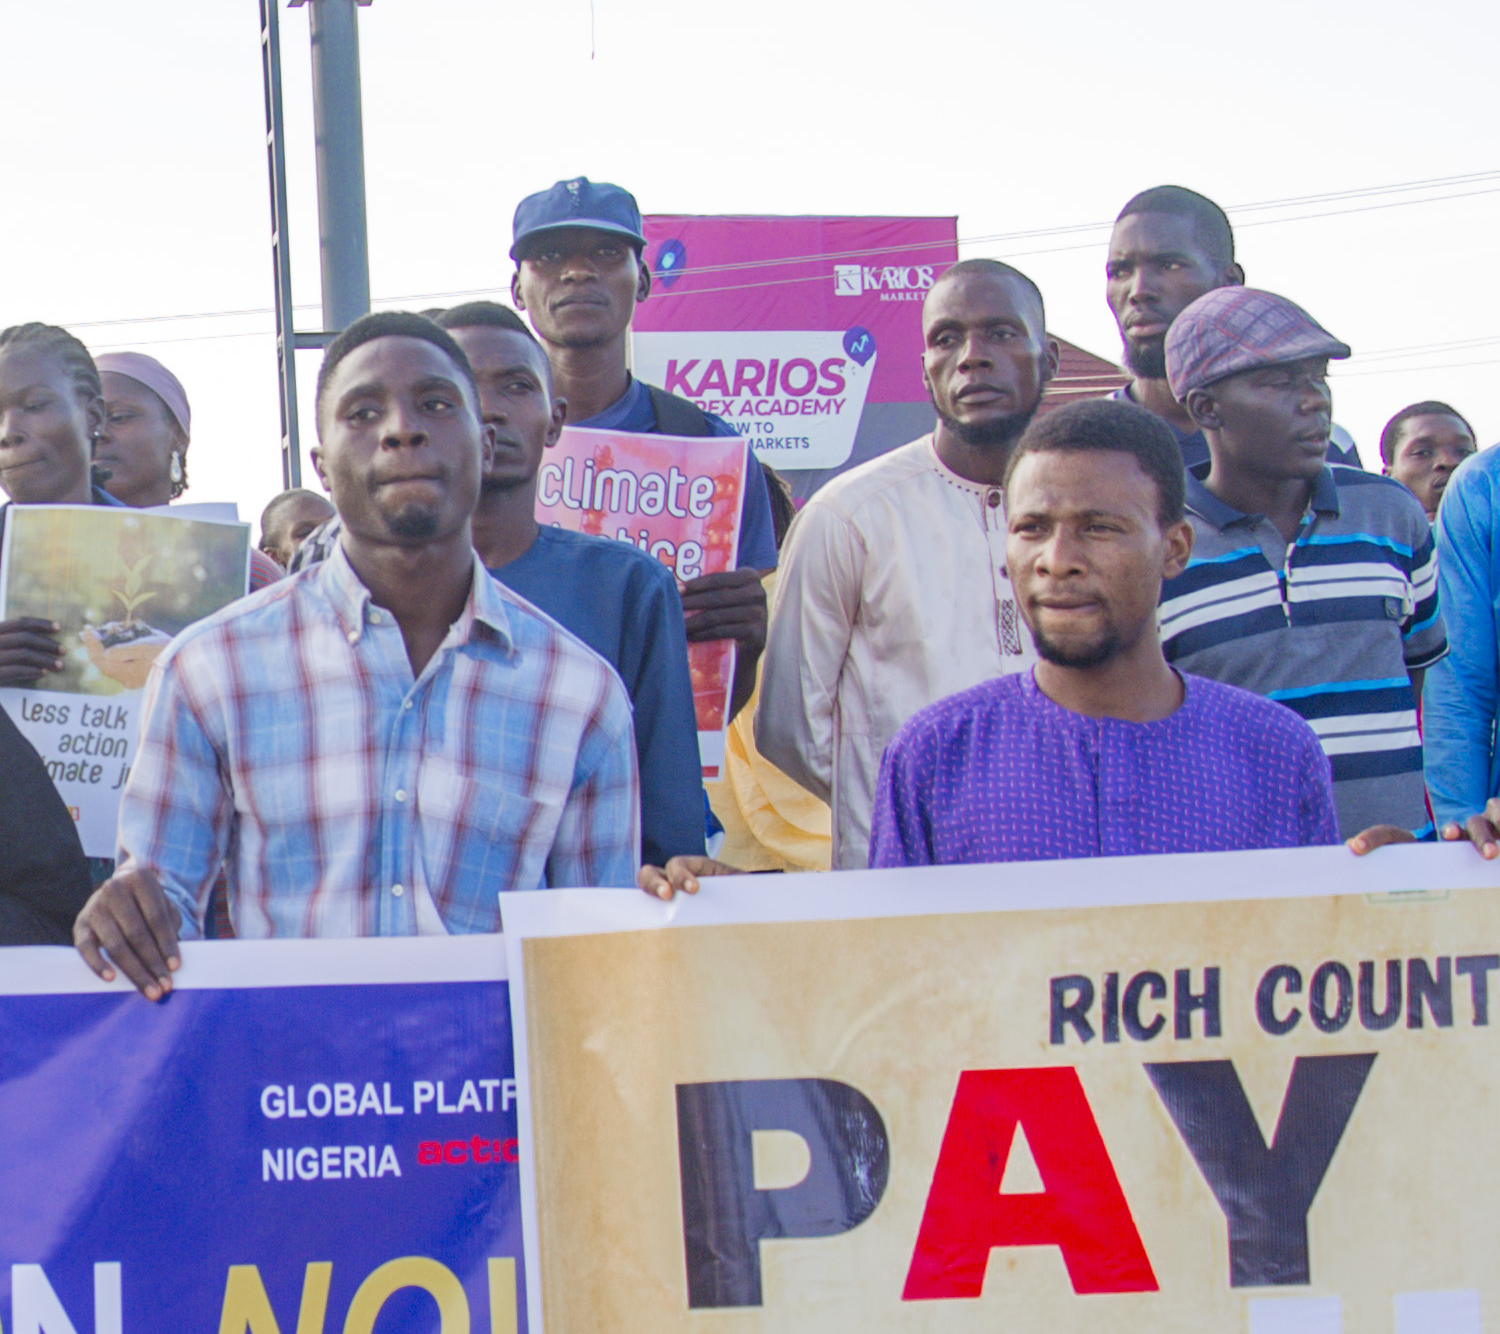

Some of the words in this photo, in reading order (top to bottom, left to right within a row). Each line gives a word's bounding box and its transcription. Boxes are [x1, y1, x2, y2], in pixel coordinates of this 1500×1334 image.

[863, 265, 934, 290] KARIOS
[880, 292, 928, 301] MARKET
[664, 357, 847, 397] KARIOS
[696, 399, 734, 416] REX
[739, 398, 847, 416] ACADEMY
[755, 422, 774, 434] TO
[538, 457, 716, 518] climate
[80, 703, 129, 730] talk
[58, 732, 129, 758] action
[1049, 966, 1223, 1046] RICH
[260, 1082, 404, 1119] GLOBAL
[413, 1078, 517, 1114] PLATF
[262, 1145, 401, 1182] NIGERIA
[674, 1051, 1379, 1309] PAY
